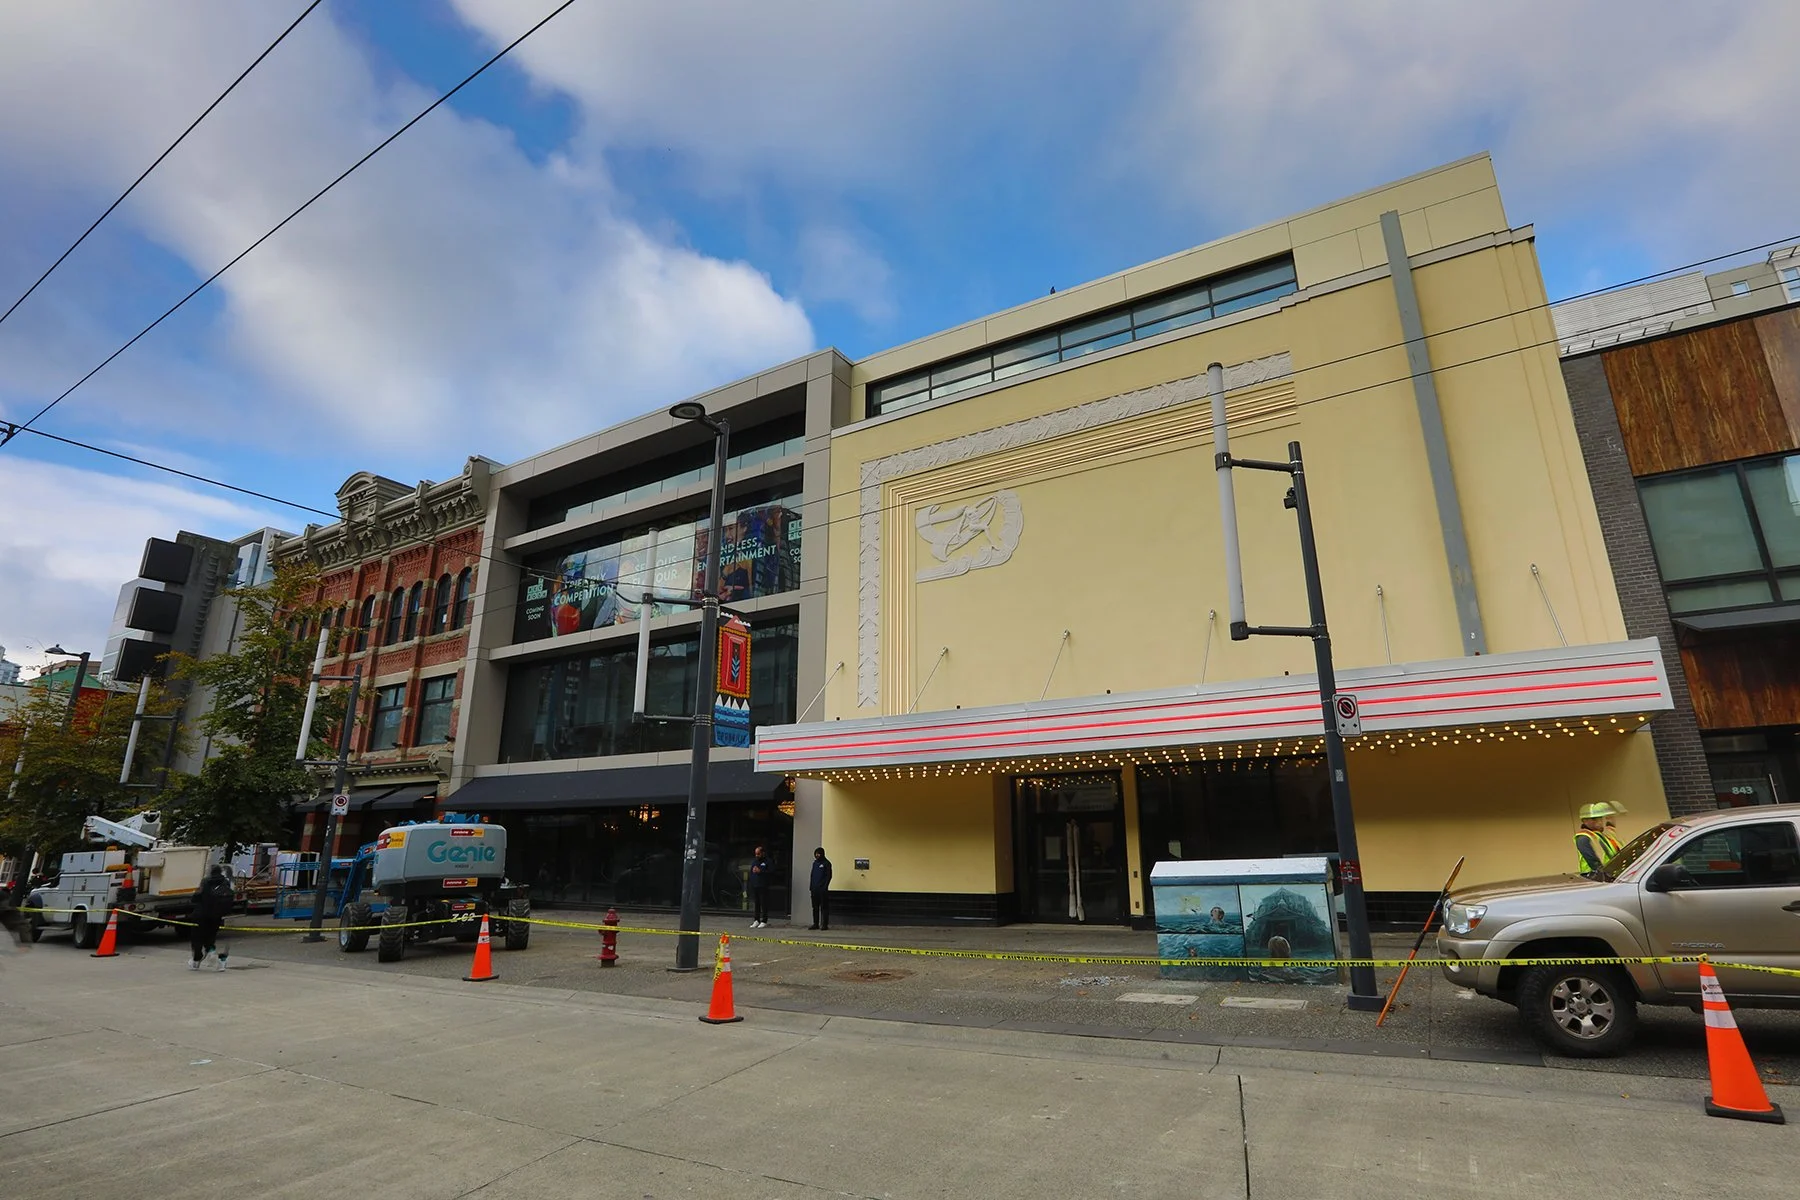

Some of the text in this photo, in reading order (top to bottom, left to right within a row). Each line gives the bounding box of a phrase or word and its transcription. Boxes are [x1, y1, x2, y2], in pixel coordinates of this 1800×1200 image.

[720, 537, 759, 556] NDLESS
[554, 583, 615, 606] COMPETITION
[1732, 786, 1754, 795] 843
[427, 841, 496, 863] Genie
